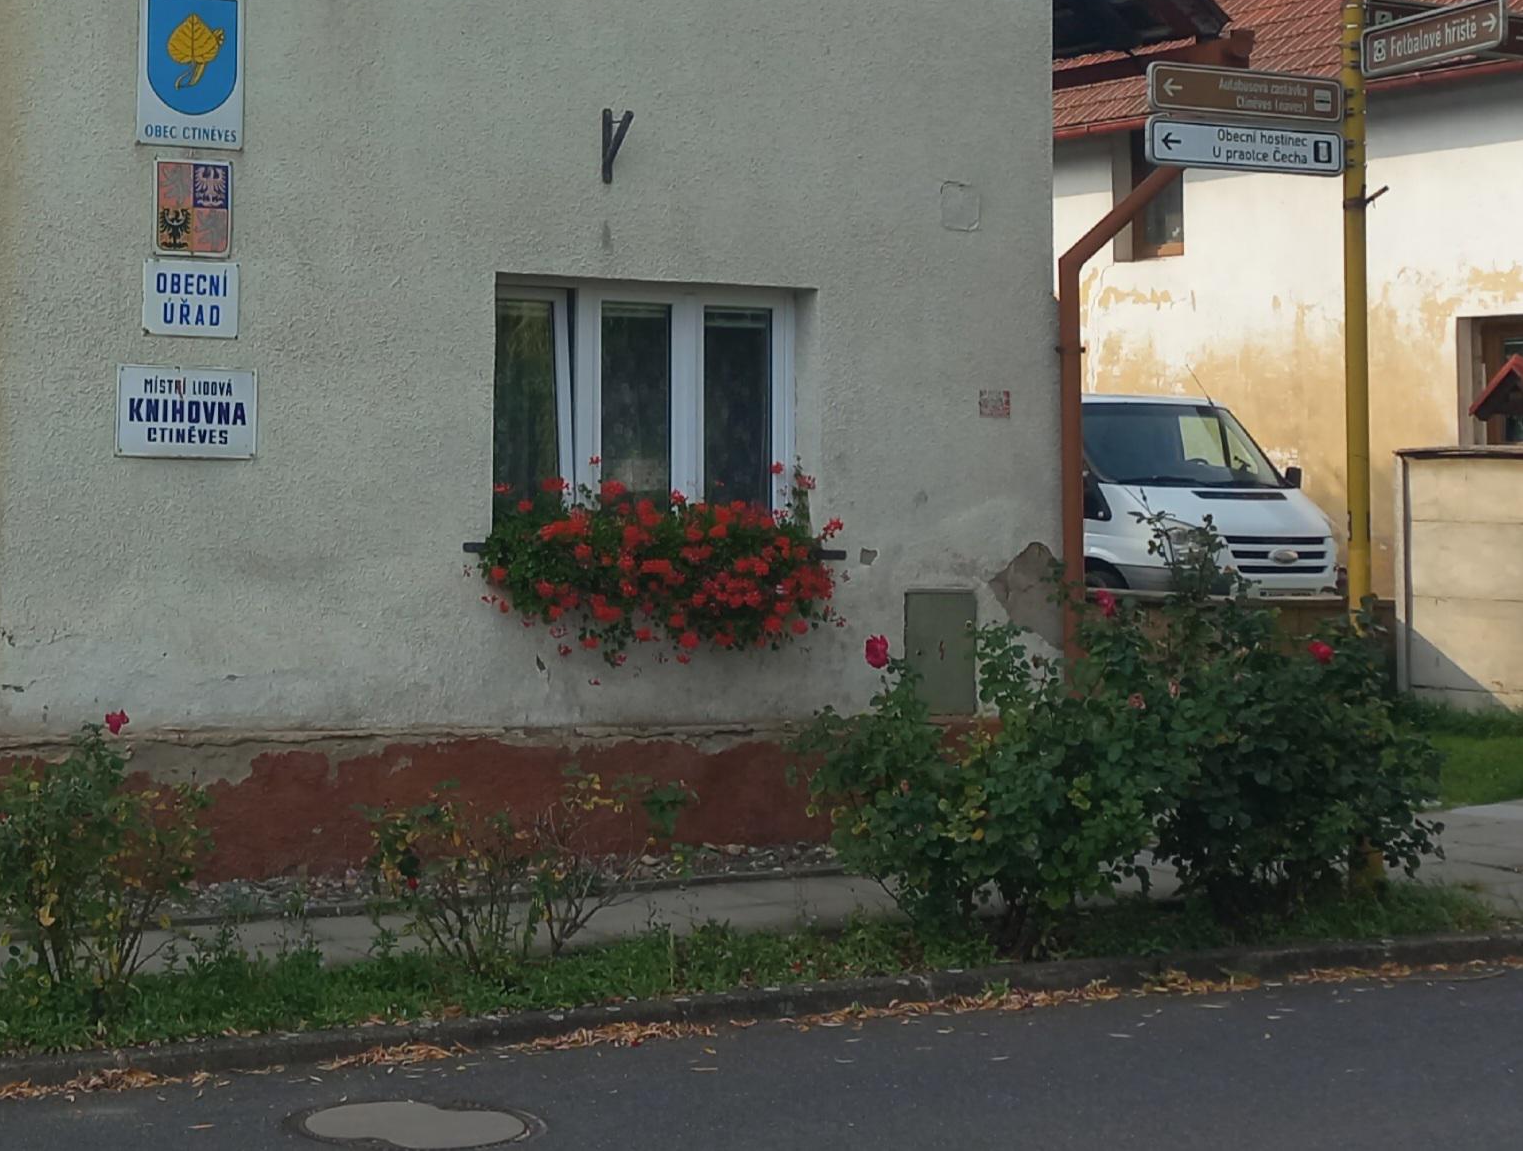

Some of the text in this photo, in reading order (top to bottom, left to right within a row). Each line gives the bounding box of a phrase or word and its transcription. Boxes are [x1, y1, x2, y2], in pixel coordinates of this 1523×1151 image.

[1390, 14, 1477, 57] Fotbalové hřiště
[144, 124, 238, 143] OBEC CTINĚVES
[1217, 128, 1308, 147] Obecní hostinec
[1212, 146, 1222, 158] U
[1272, 146, 1308, 164] Čecha
[156, 268, 228, 297] OBECNÍ
[162, 297, 221, 327] ÚŘAD
[143, 374, 233, 397] MÍSTNÍ LIDOVÁ
[128, 397, 247, 426] KNIHOVNA
[147, 426, 229, 445] CTINĚVES
